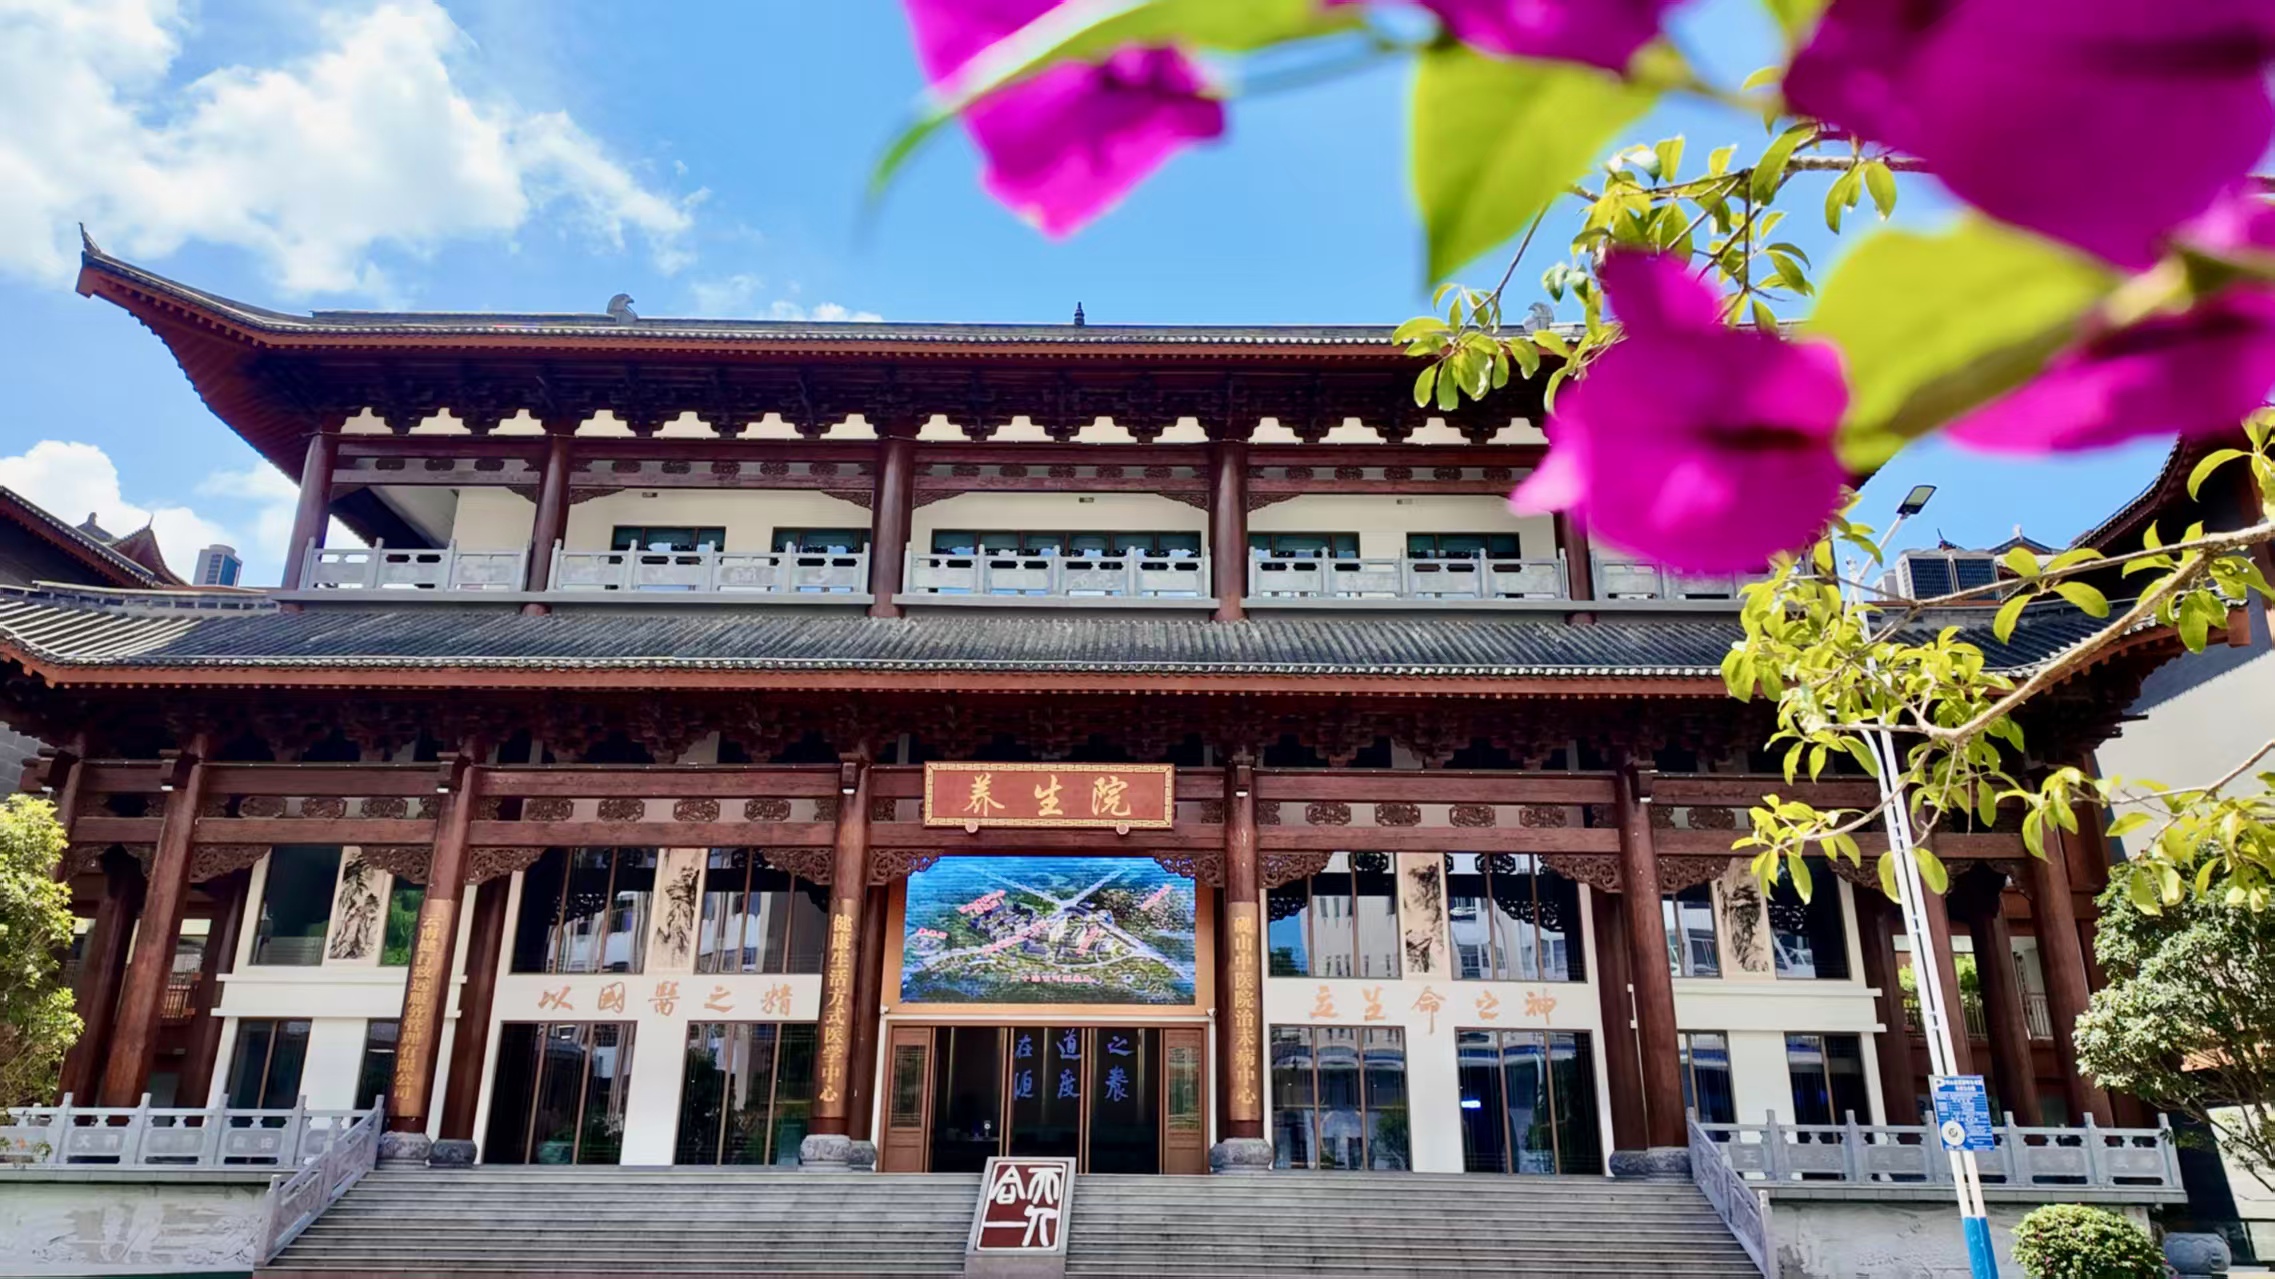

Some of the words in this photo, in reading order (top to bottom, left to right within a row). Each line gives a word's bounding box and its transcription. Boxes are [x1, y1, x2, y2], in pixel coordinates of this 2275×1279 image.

[963, 772, 1131, 817] 养生院
[819, 913, 853, 1103] 健康生活方式医学中心
[1309, 984, 1558, 1035] 立生命之神
